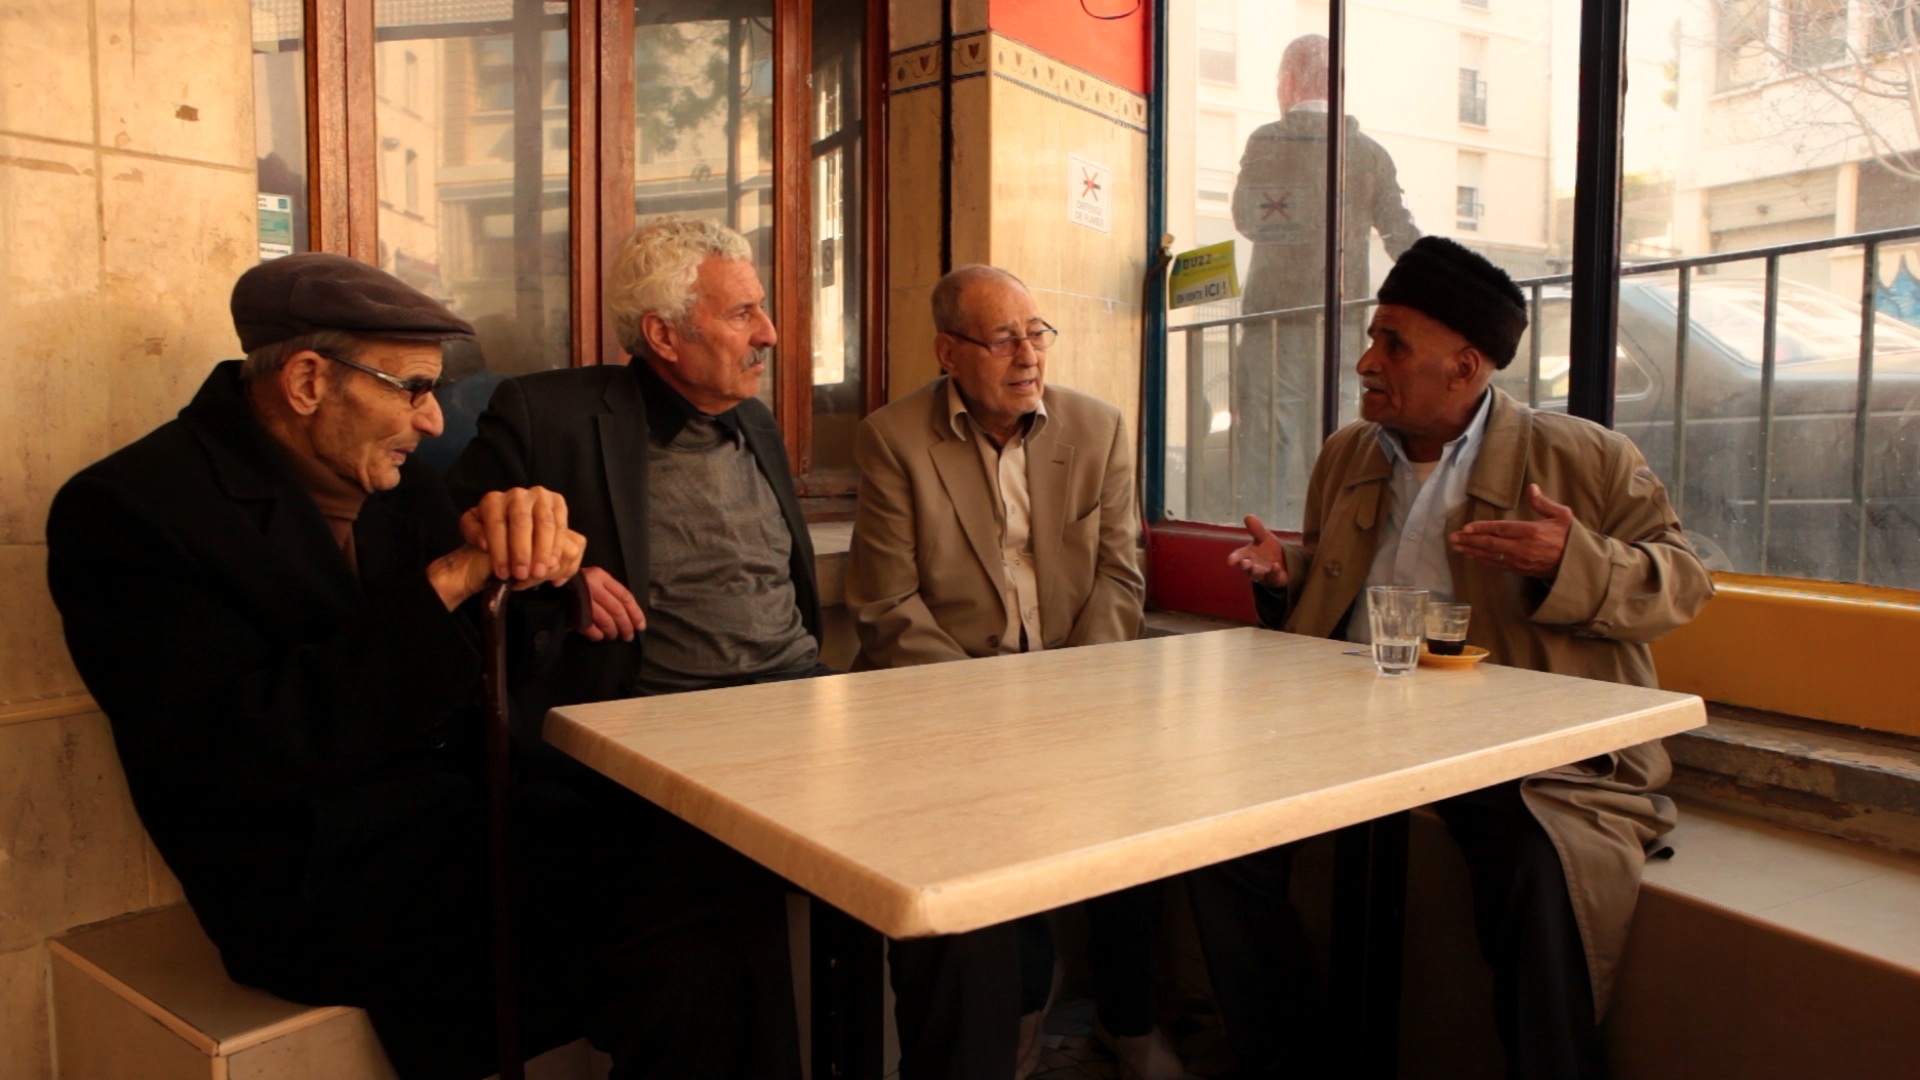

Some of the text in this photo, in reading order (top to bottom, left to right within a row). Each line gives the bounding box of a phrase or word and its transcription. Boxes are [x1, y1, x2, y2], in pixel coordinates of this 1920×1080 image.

[1075, 210, 1105, 227] DE FUMER
[1183, 253, 1212, 270] BUZZ
[1176, 294, 1184, 304] EN
[1185, 290, 1203, 302] VENTE
[1205, 282, 1219, 298] ICI
